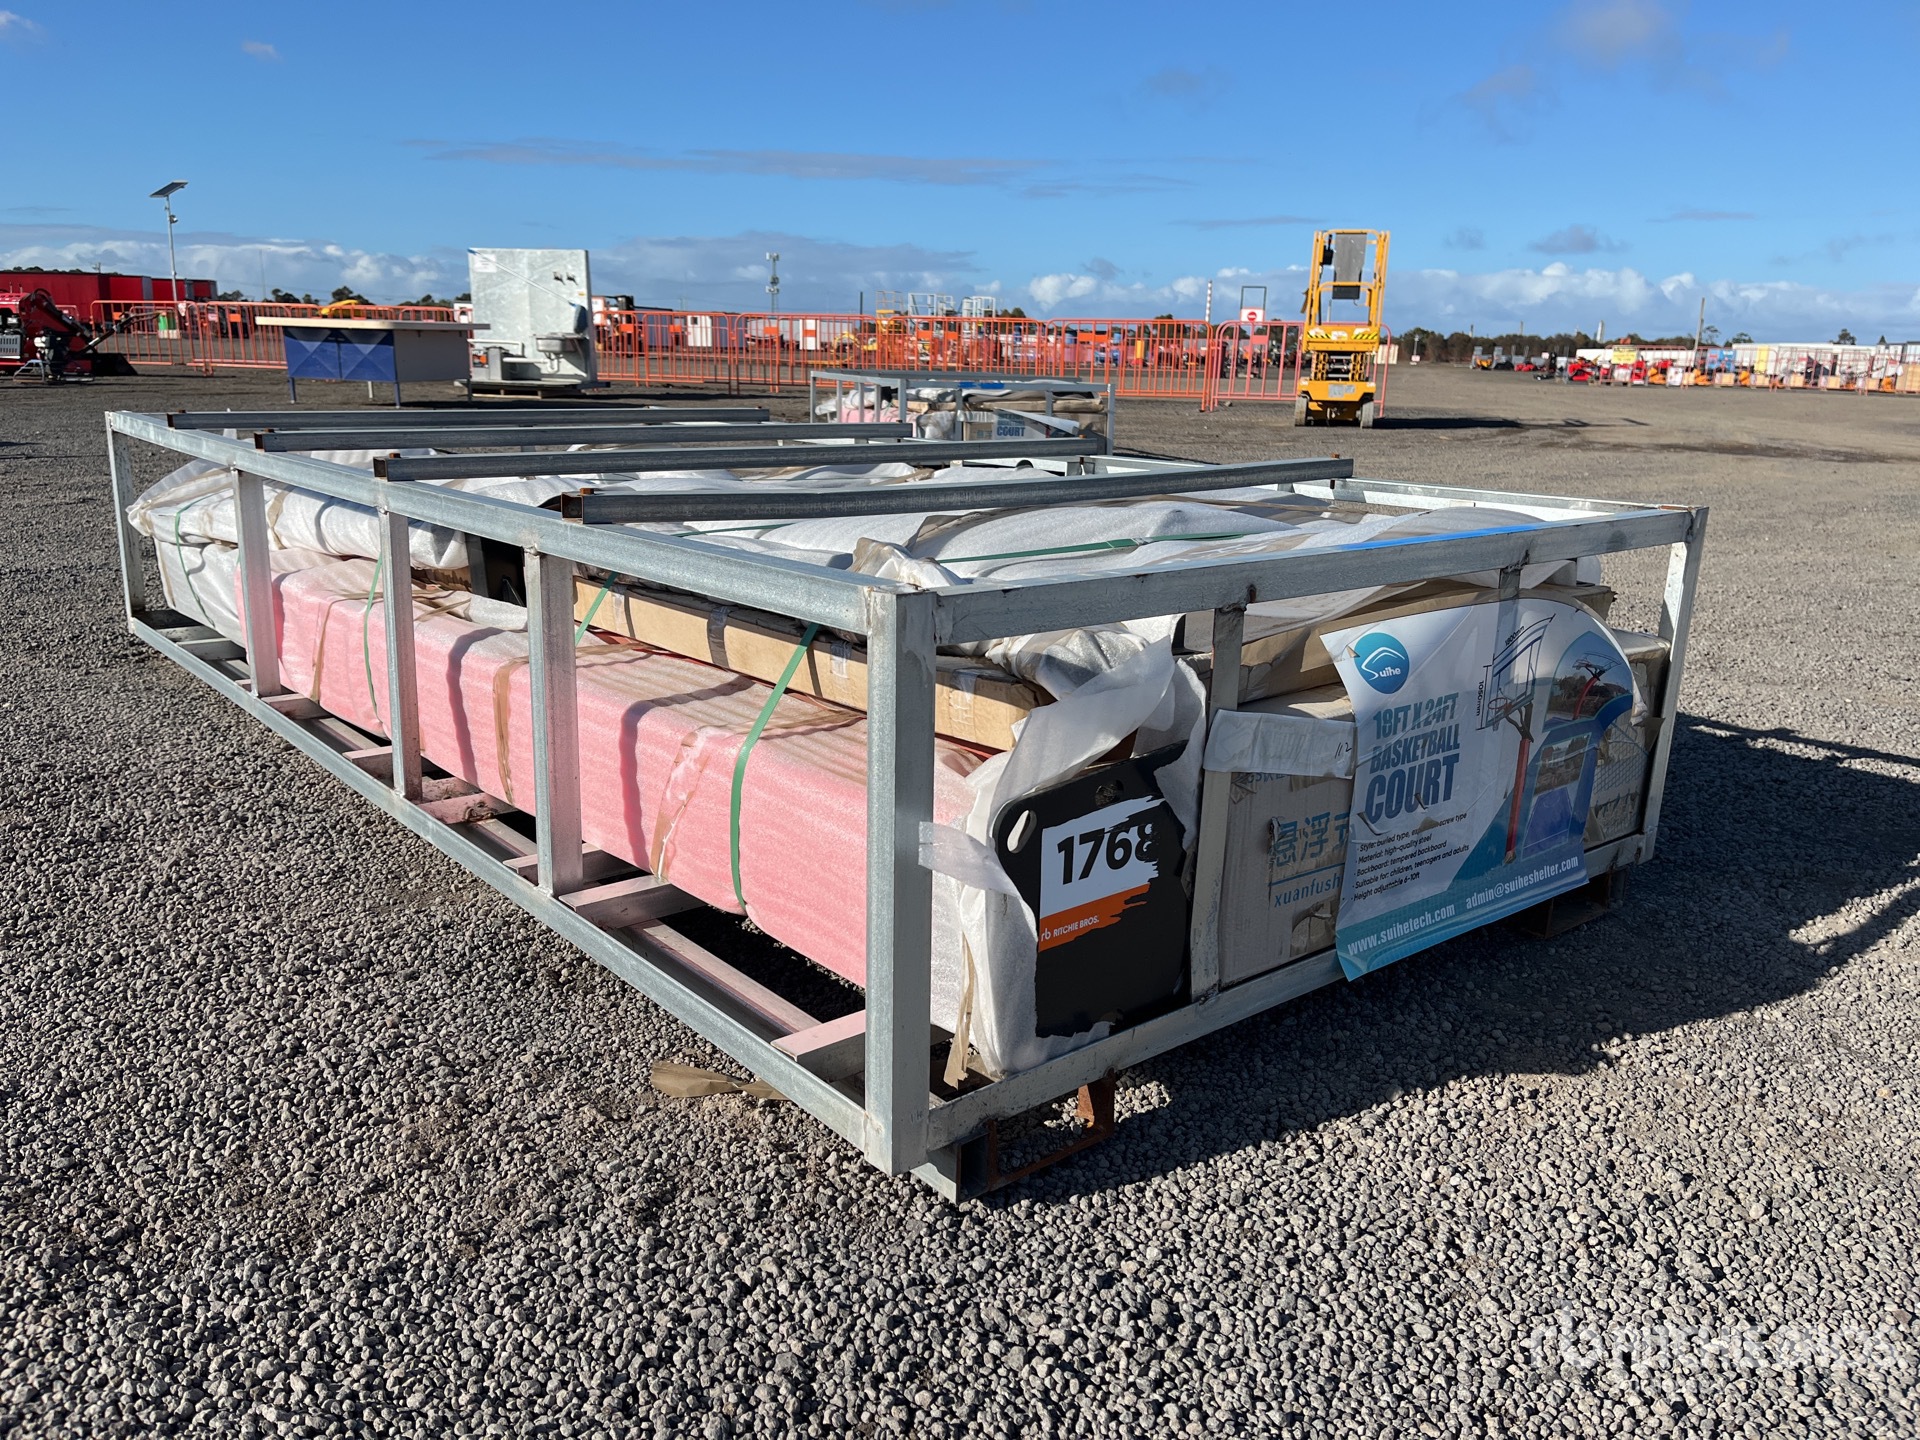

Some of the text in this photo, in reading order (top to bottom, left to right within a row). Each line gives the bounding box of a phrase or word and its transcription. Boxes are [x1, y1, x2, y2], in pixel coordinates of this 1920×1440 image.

[997, 426, 1025, 437] COURT
[1476, 680, 1485, 717] 1050mm
[1369, 723, 1460, 774] BASKETBALL
[1364, 753, 1460, 824] COURT
[1057, 823, 1156, 885] 1768
[1356, 840, 1448, 877] Backboard: tempered backboard
[1358, 833, 1433, 865] Material: high-quality steel
[1360, 841, 1376, 852] Style:
[1377, 835, 1396, 847] buried
[1355, 875, 1379, 889] Suitable
[1414, 855, 1441, 869] teenagers
[1442, 848, 1453, 859] and
[1347, 855, 1579, 957] www.suihetech.com admin@suiheshelter.com
[1353, 888, 1373, 901] Height
[1053, 921, 1079, 938] RITCHIE
[1079, 915, 1100, 929] BROS.
